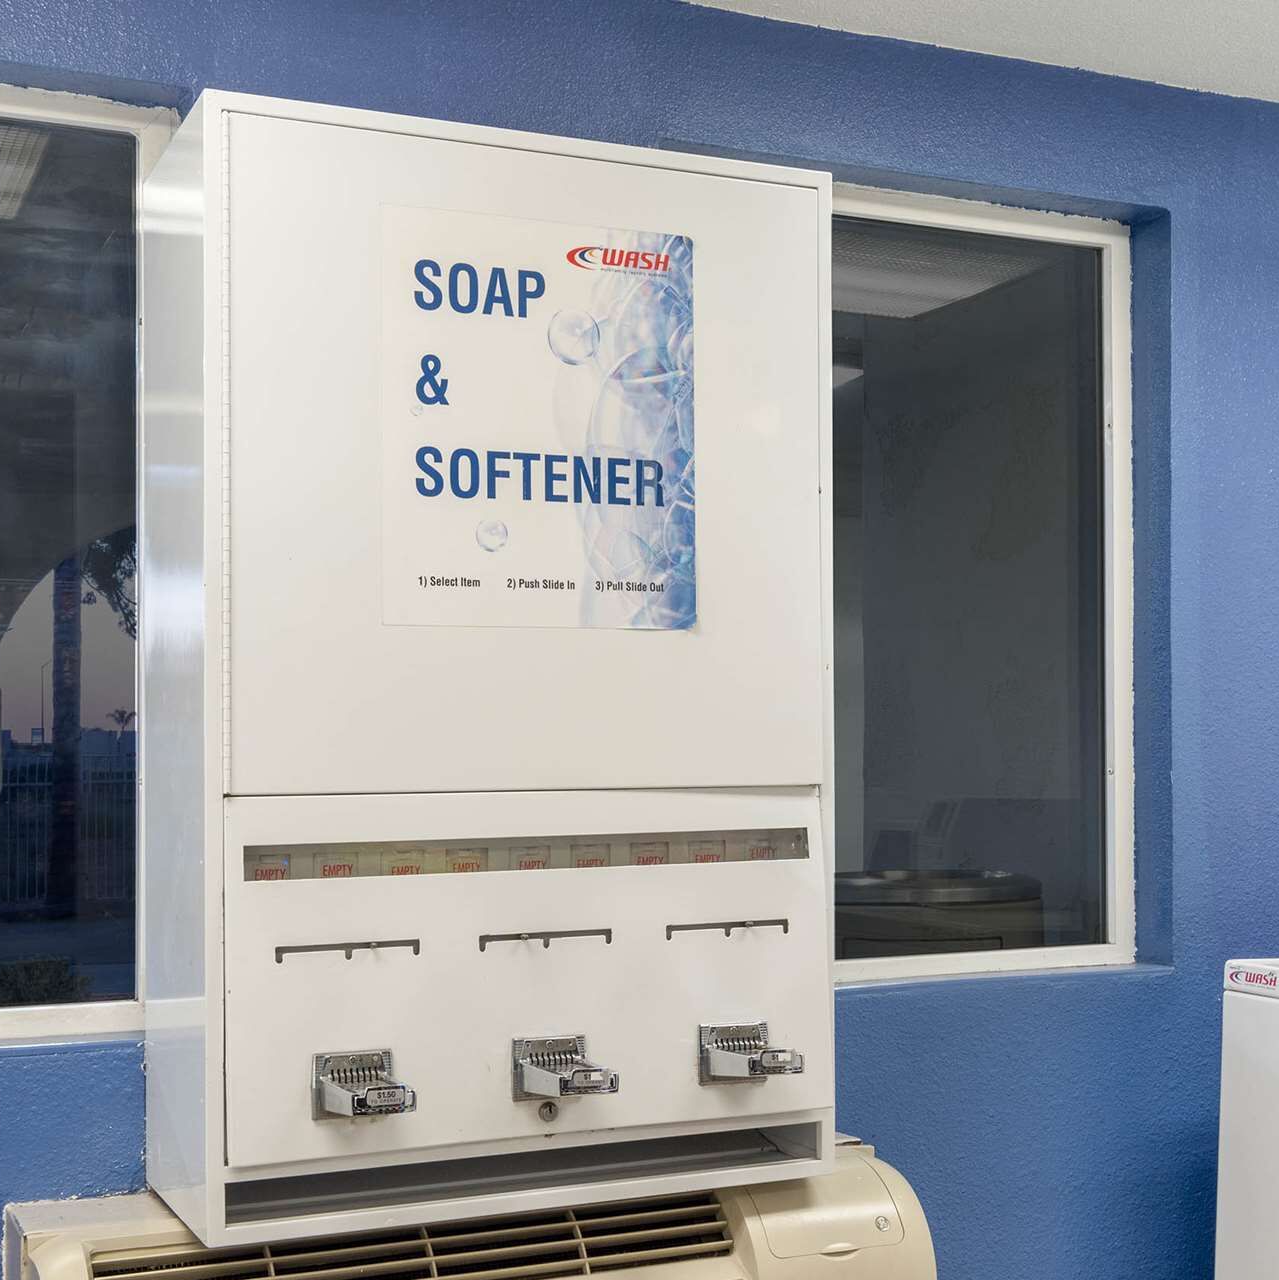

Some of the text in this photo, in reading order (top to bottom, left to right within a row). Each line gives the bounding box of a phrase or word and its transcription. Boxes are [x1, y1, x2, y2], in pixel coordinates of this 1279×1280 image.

[601, 248, 670, 272] WASH
[414, 259, 546, 319] SOAP
[415, 354, 450, 406] &
[415, 446, 665, 507] SOFTENER
[418, 576, 481, 588] 1) Select Item
[507, 578, 576, 590] 2) Push Slide In
[595, 580, 664, 593] 3) Pull Slide Out
[322, 864, 353, 877] EMPTY
[391, 864, 421, 875] EMPTY
[452, 861, 481, 872] EMPTY
[255, 868, 287, 881] EMPTY
[1244, 971, 1277, 987] WASH
